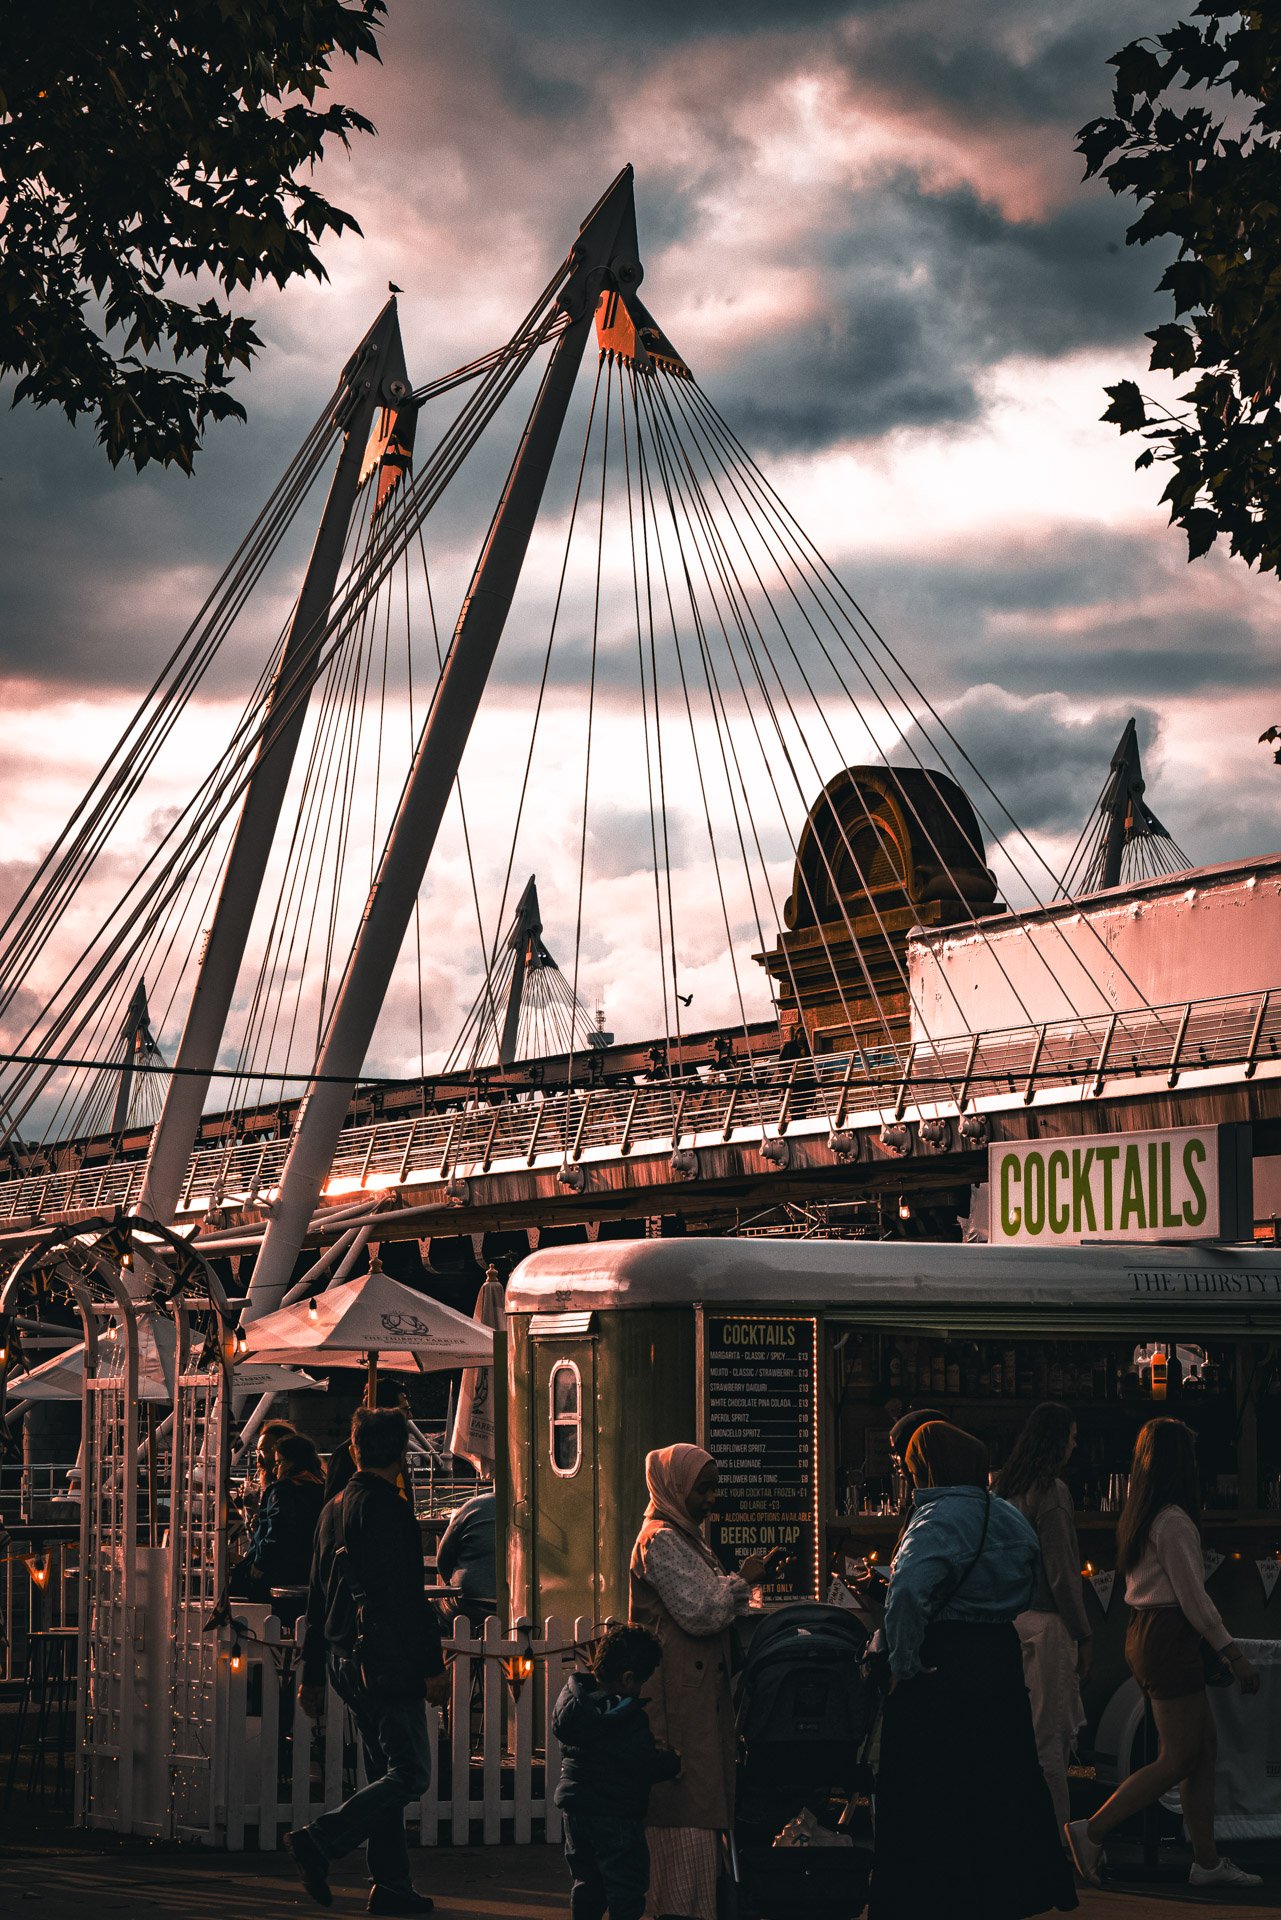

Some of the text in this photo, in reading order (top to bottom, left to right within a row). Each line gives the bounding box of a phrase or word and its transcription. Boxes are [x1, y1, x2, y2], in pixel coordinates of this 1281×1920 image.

[1000, 1138, 1207, 1237] COCKTAILS
[1127, 1273, 1176, 1291] THE
[1178, 1273, 1267, 1292] THIRSTY
[723, 1324, 796, 1346] COCKTAILS
[710, 1351, 741, 1360] MARGARITA
[744, 1352, 766, 1361] CLASSIC
[770, 1352, 786, 1361] SPICY
[798, 1352, 809, 1361] £13
[710, 1368, 729, 1377] MOJITO
[732, 1368, 755, 1377] CLASSIC
[759, 1368, 794, 1378] STRAWBERRY
[798, 1369, 809, 1378] £13
[710, 1383, 745, 1392] STRAWBERRY
[798, 1384, 809, 1393] £13
[710, 1398, 728, 1407] WHITE
[728, 1398, 758, 1408] CHOCOLATE
[770, 1398, 792, 1408] COLADA
[710, 1413, 731, 1422] APEROL
[731, 1413, 750, 1422] SPRITZ
[710, 1428, 742, 1437] LIMONCELLO
[742, 1429, 761, 1438] SPRITZ
[710, 1444, 748, 1453] ELDERFLOWER
[748, 1444, 766, 1453] SPRITZ
[734, 1459, 762, 1469] LEMONADE
[748, 1474, 758, 1484] GIN
[729, 1488, 745, 1498] YOUR
[745, 1488, 772, 1498] COCKTAIL
[773, 1488, 796, 1498] FROZEN
[725, 1512, 756, 1522] ALCOHOLIC
[756, 1512, 780, 1522] OPTIONS
[780, 1511, 812, 1522] AVAILABLE
[720, 1526, 801, 1545] BEERS ON TAP
[776, 1583, 794, 1593] ONLY
